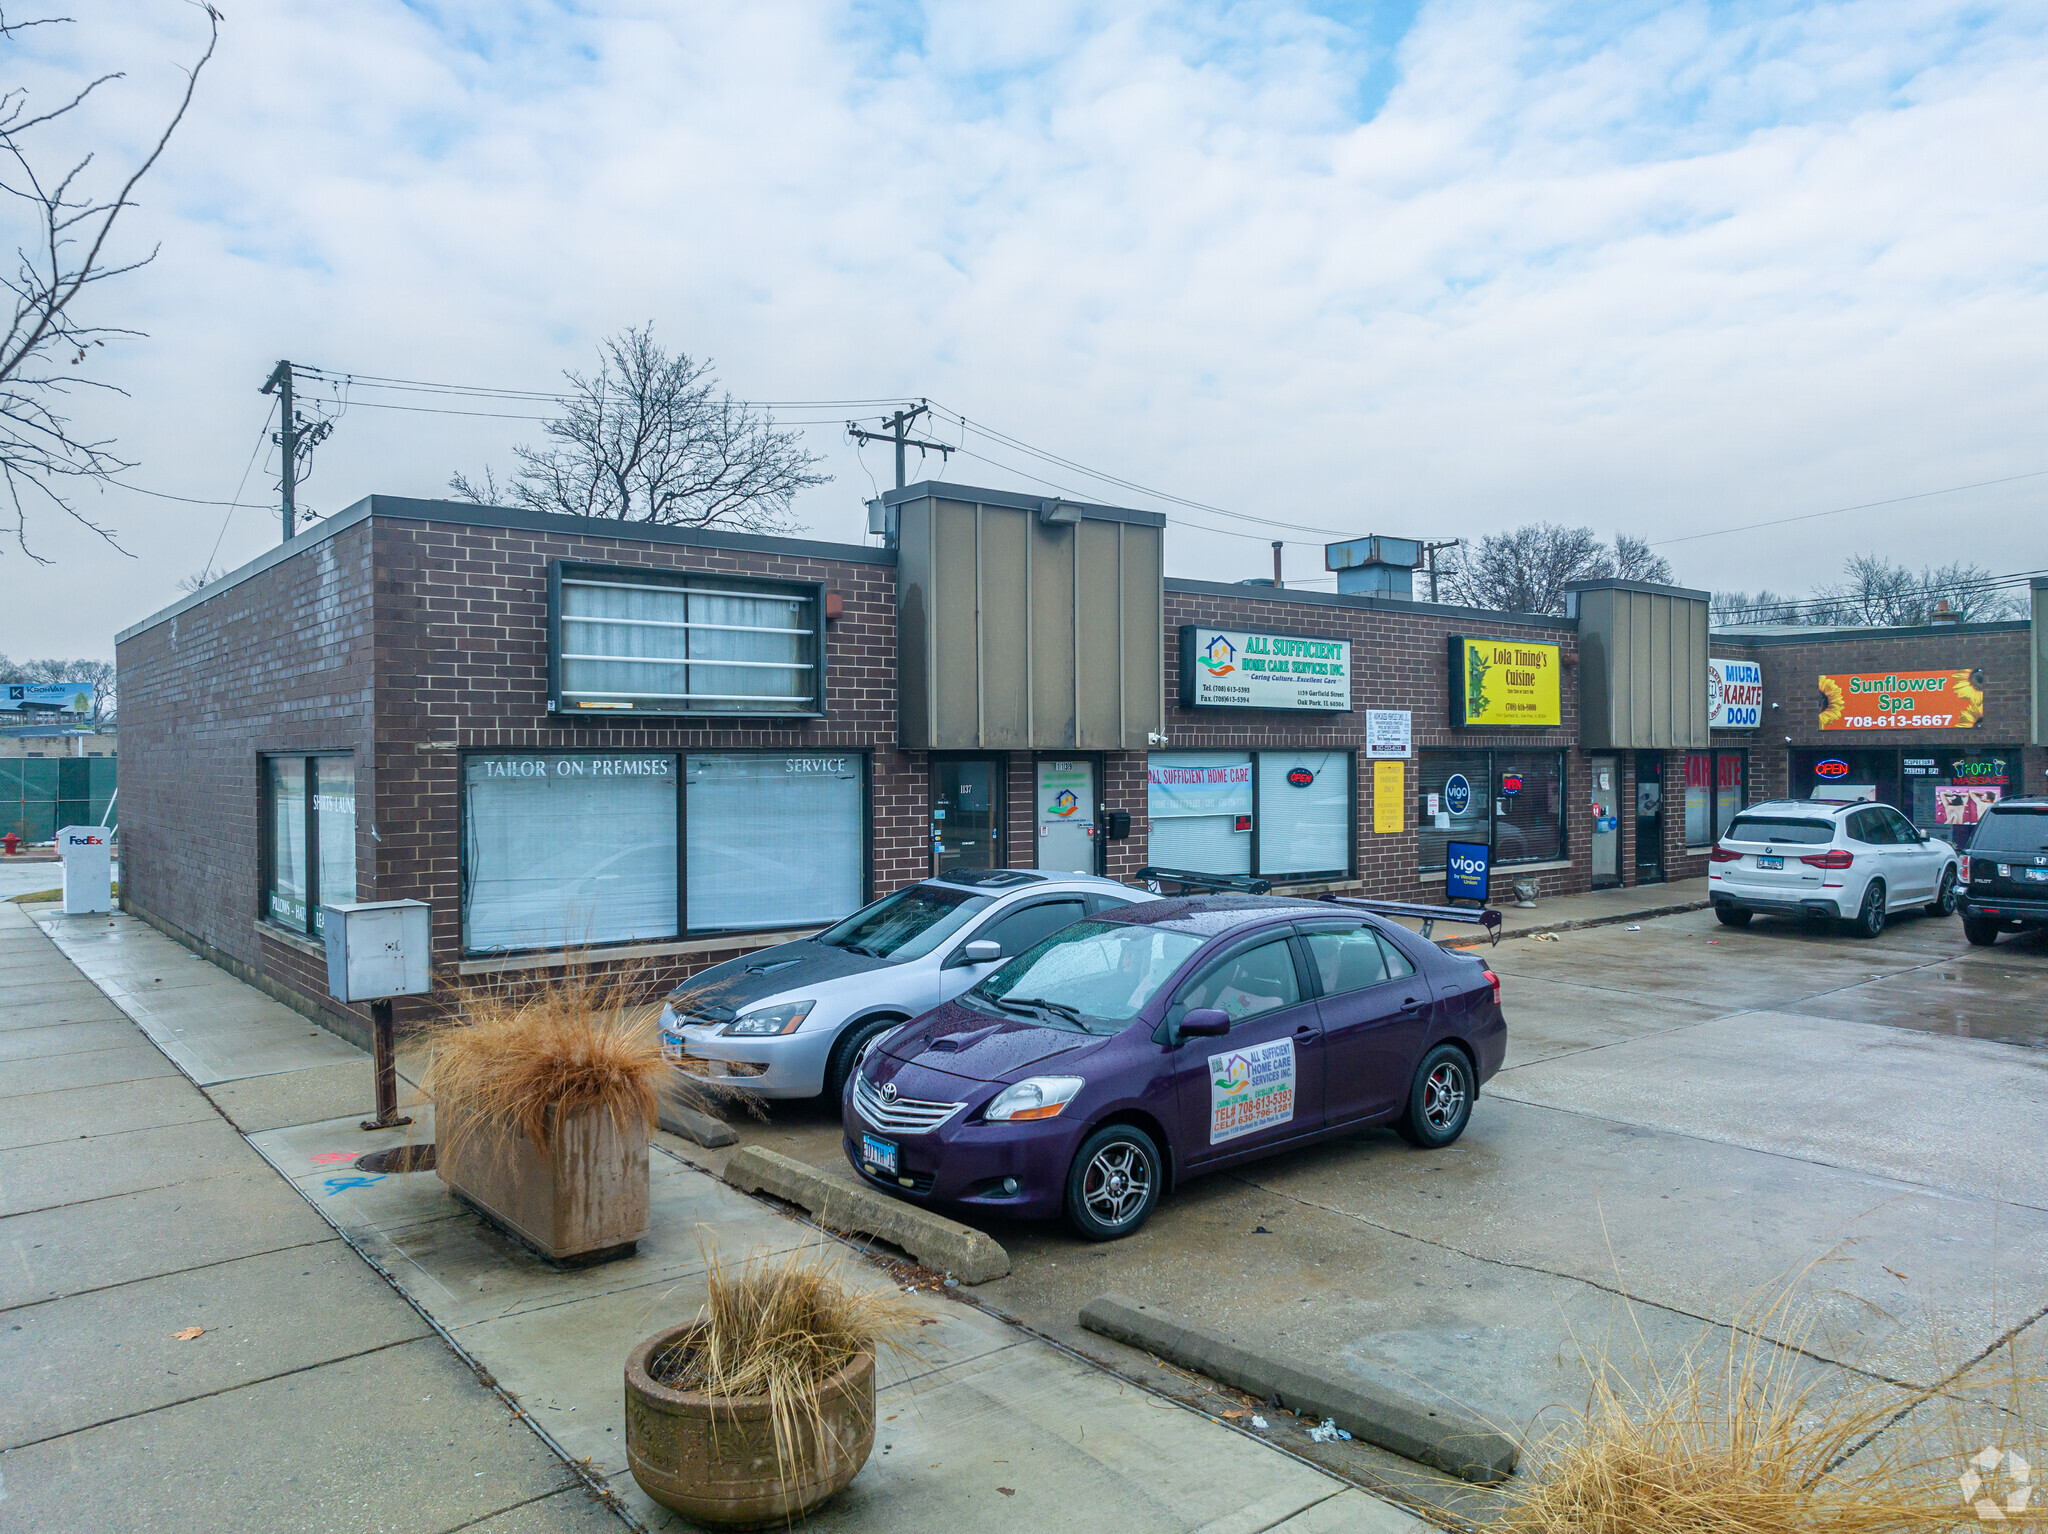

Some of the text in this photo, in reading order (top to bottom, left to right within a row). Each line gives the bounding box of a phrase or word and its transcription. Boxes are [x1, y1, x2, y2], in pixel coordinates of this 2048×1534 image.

[1245, 637, 1343, 660] ALL SUFFICIENT
[1241, 658, 1345, 676] HOME CARE SERVICES INC.
[1493, 648, 1547, 669] Lola Tining's
[1250, 673, 1270, 682] Caring
[1324, 676, 1337, 684] Care
[1505, 669, 1535, 686] Cuisine
[1725, 665, 1760, 683] MIURA
[1212, 685, 1226, 693] (708)
[1227, 685, 1250, 694] 613-5393
[1849, 675, 1947, 694] Sunflower
[1723, 685, 1763, 705] KARATE
[1878, 694, 1914, 714] Spa
[1727, 707, 1757, 724] DOJO
[1844, 714, 1953, 728] 708-613-5667
[484, 759, 668, 777] TAILOR ON PREMISES
[785, 758, 845, 773] SERVICE
[1685, 755, 1742, 787] KARATE
[1815, 763, 1849, 775] OPEN
[1965, 762, 1992, 776] FOOT
[1147, 768, 1249, 784] ALL SUFFICIENT HOME CARE
[1290, 773, 1312, 783] OPEN
[1503, 778, 1523, 790] OPEN
[1953, 776, 2009, 785] MASSAGE
[960, 784, 972, 794] 1137
[1448, 784, 1468, 799] vigo
[313, 794, 333, 812] SHIRTS
[69, 836, 103, 845] FedEx
[1450, 855, 1486, 874] vigo
[272, 895, 290, 916] PILLOWS
[295, 904, 307, 922] HAT
[1250, 1043, 1290, 1064] ALL SUFFICIENT
[1252, 1056, 1291, 1076] HOME CARE
[1252, 1069, 1292, 1087] SERVICES INC.
[1214, 1089, 1293, 1122] TEL# 708-613-5393
[1214, 1102, 1292, 1132] CEL# 630-796-1281
[863, 1142, 885, 1164] EDITH
